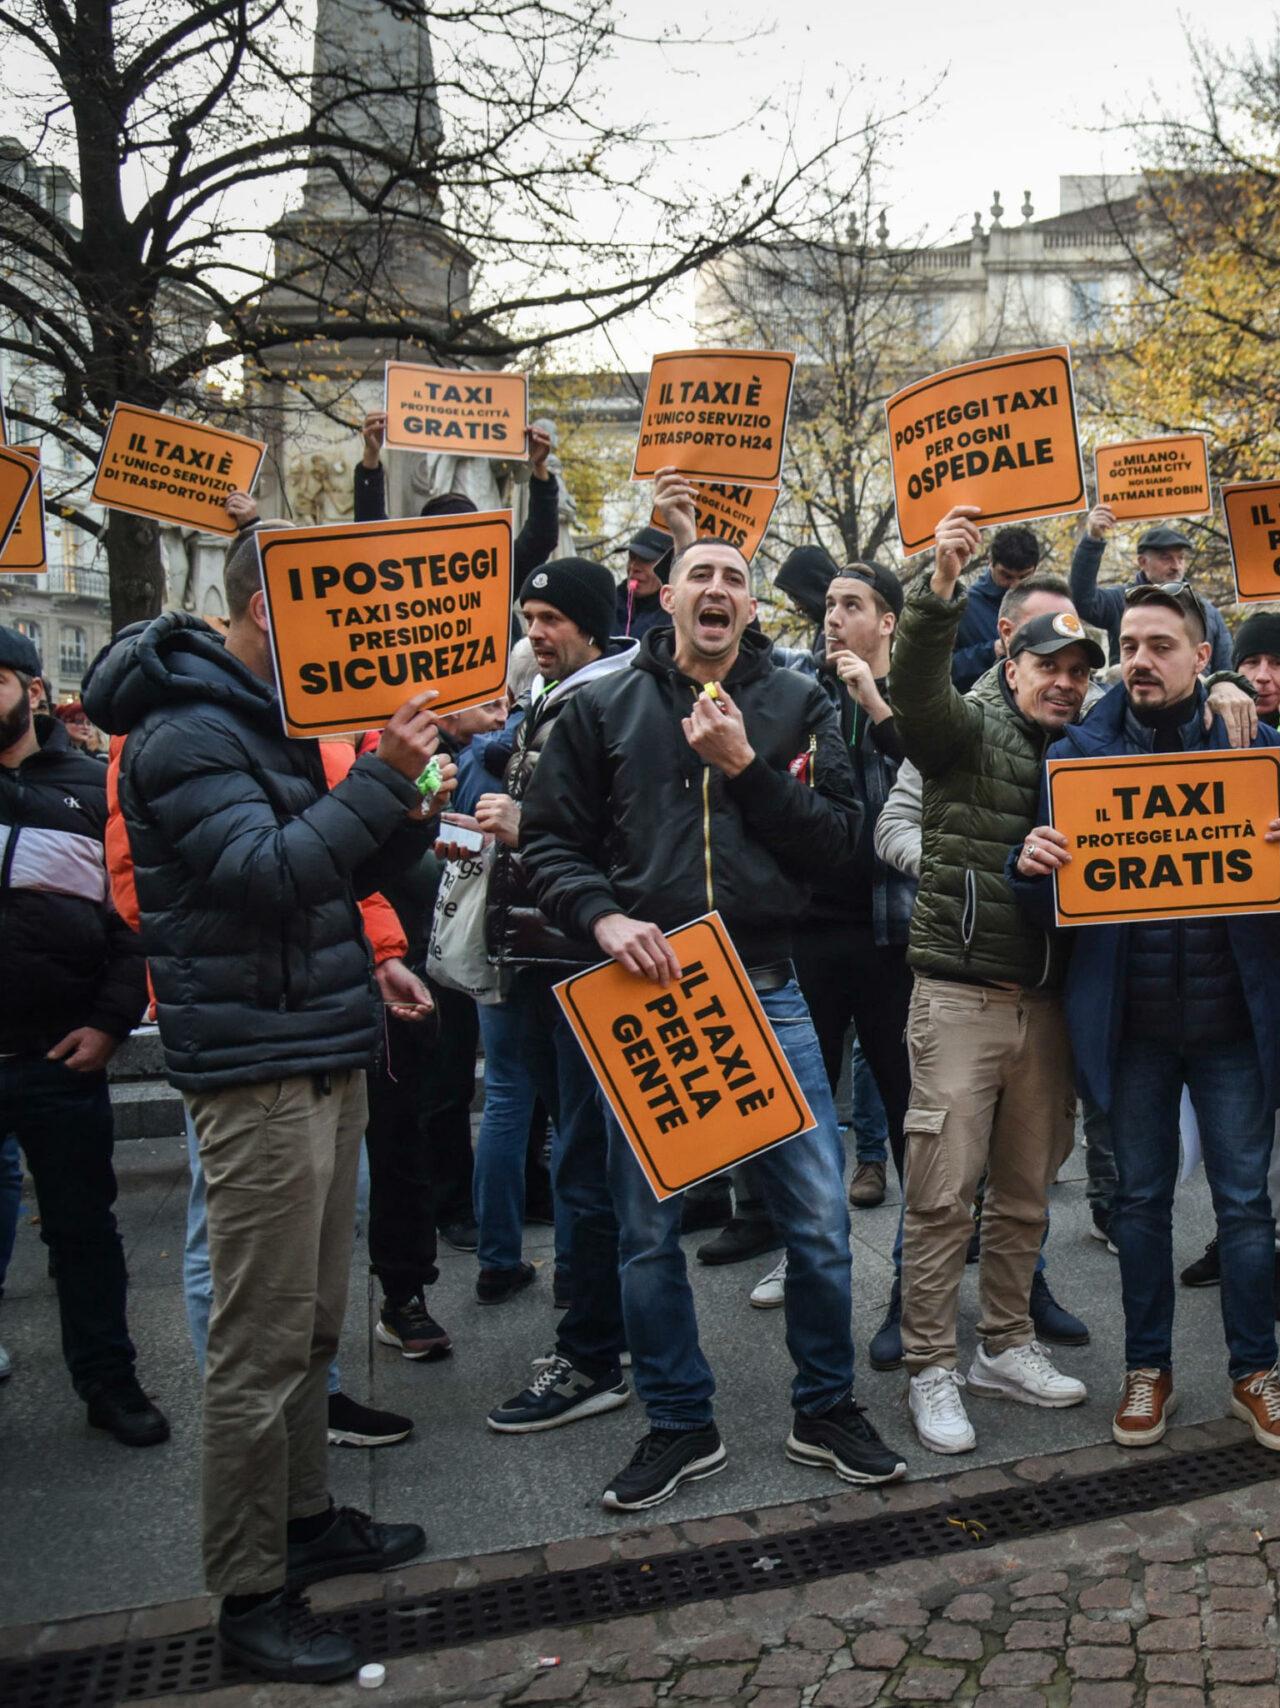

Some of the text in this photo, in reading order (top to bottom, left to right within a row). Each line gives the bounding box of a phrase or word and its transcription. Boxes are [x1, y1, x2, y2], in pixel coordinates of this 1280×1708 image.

[414, 382, 492, 404] IL TAXI
[660, 375, 762, 406] IL TAXI È
[401, 402, 458, 415] PROTEGGE
[477, 409, 510, 418] CITTÀ
[648, 411, 770, 428] L'UNICO SERVIZIO
[896, 386, 1058, 451] POSTEGGI TAXI
[403, 416, 507, 440] GRATIS
[644, 431, 772, 450] DI TRASPORTO H24
[926, 424, 1010, 460] PER OGNI
[128, 433, 233, 475] IL TAXI È
[908, 438, 1054, 500] OSPEDALE
[1109, 462, 1192, 478] GOTHAM CITY
[1124, 451, 1178, 466] MILANO
[104, 468, 227, 511] DI TRASPORTO H2
[112, 453, 237, 493] L'UNICO SERVIZIO
[1145, 476, 1173, 484] SIAMO
[699, 483, 752, 507] AXI
[1103, 485, 1203, 502] BATMAN E ROBIN
[721, 504, 730, 514] LA
[733, 511, 755, 527] CITTÀ
[1251, 504, 1276, 526] IL
[288, 548, 497, 601] I POSTEGGI
[326, 592, 480, 627] TAXI SONO UN
[349, 618, 471, 652] PRESIDIO DI
[299, 636, 496, 694] SICUREZZA
[1096, 781, 1224, 822] IL TAXI
[1077, 819, 1256, 848] PROTEGGE LA CITTÀ
[1084, 848, 1253, 892] GRATIS
[676, 961, 774, 1116] IL TAXI È
[645, 993, 722, 1119] PER LA
[612, 1014, 688, 1134] GENTE
